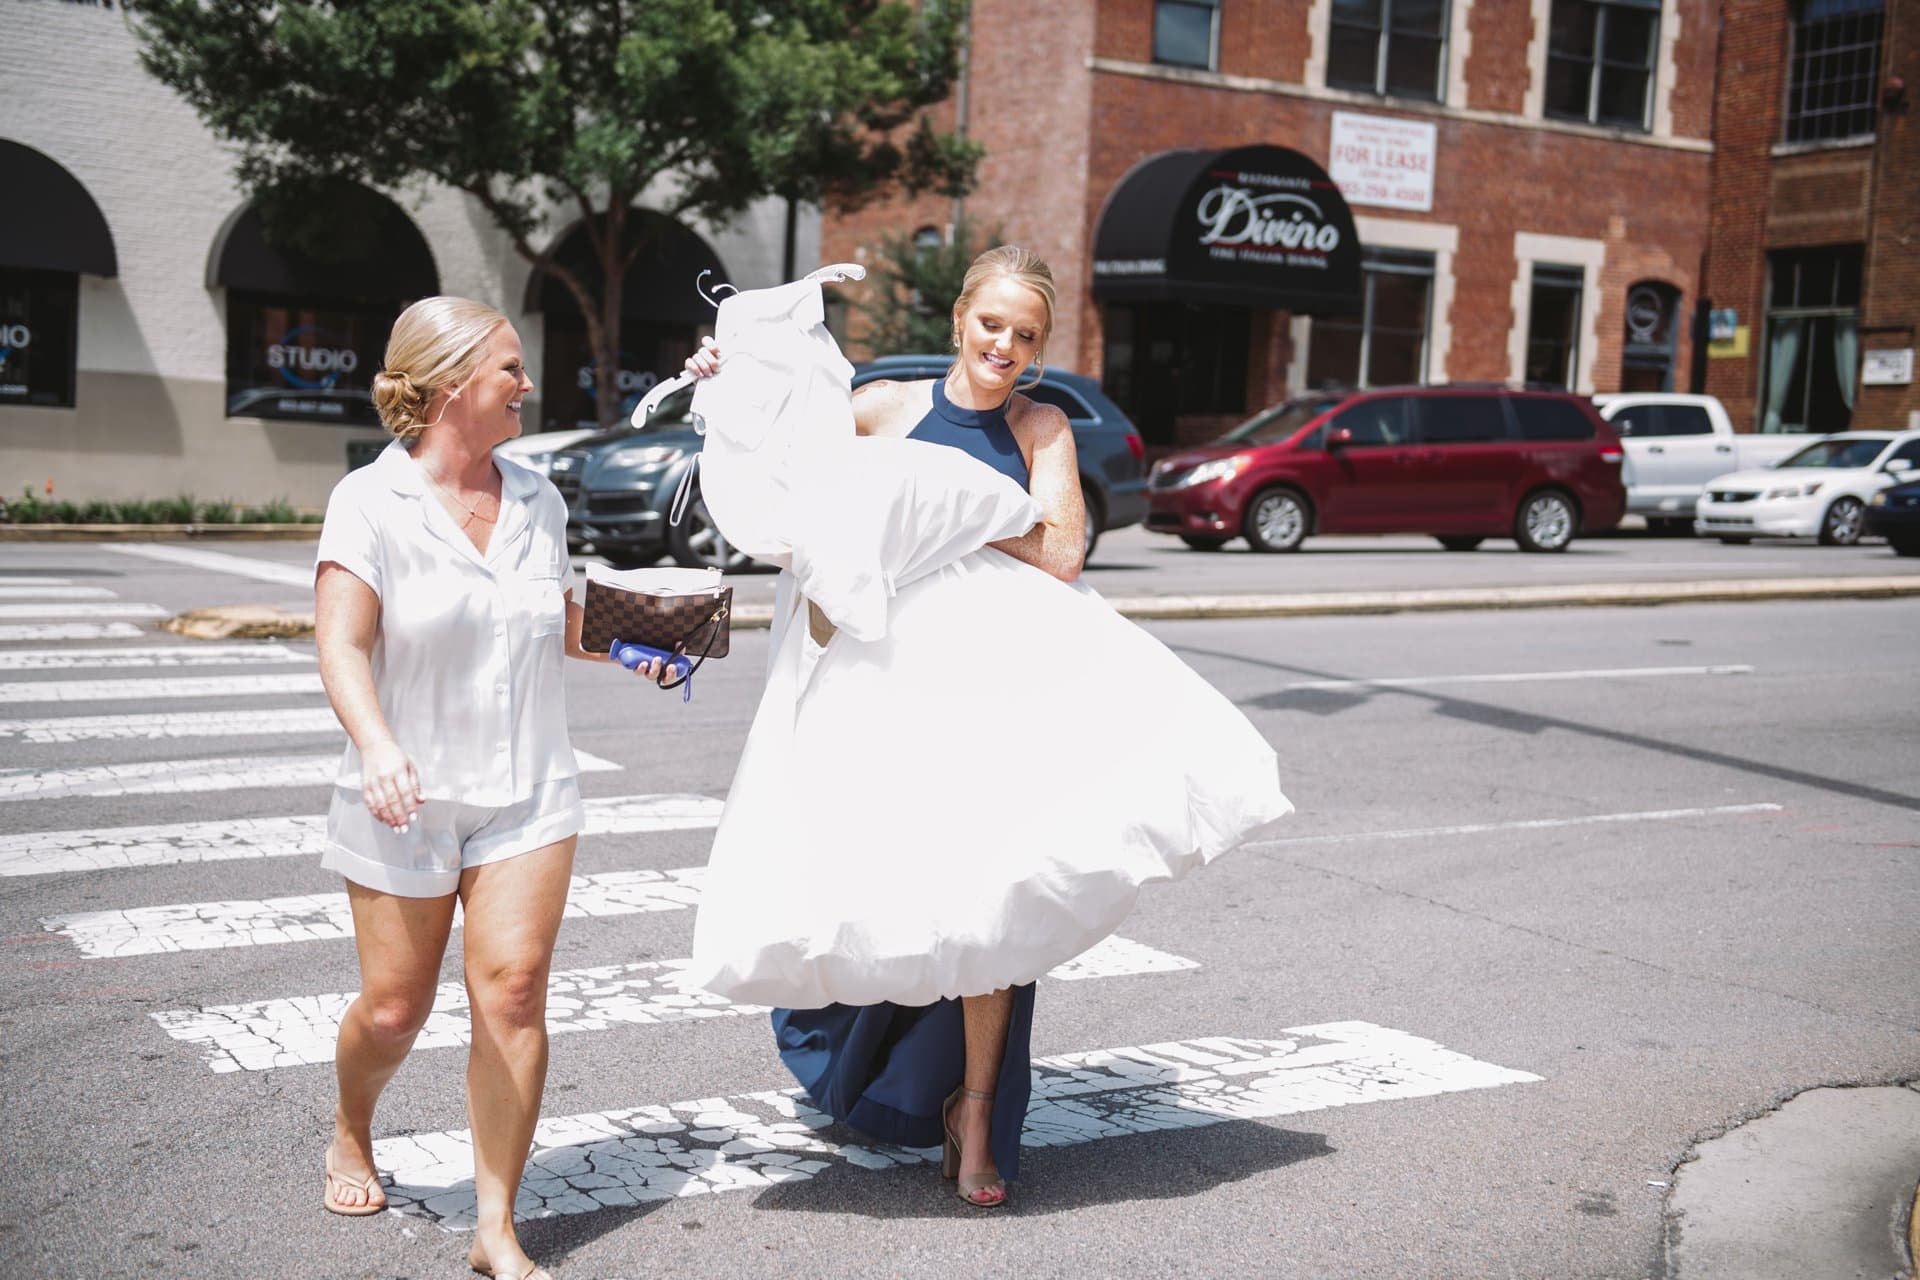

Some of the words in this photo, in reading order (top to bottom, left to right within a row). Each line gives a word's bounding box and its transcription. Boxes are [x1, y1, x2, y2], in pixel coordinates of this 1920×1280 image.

[1336, 143, 1369, 165] FOR
[1375, 149, 1428, 173] LEASE
[1197, 183, 1339, 252] Divino
[267, 343, 358, 373] STUDIO
